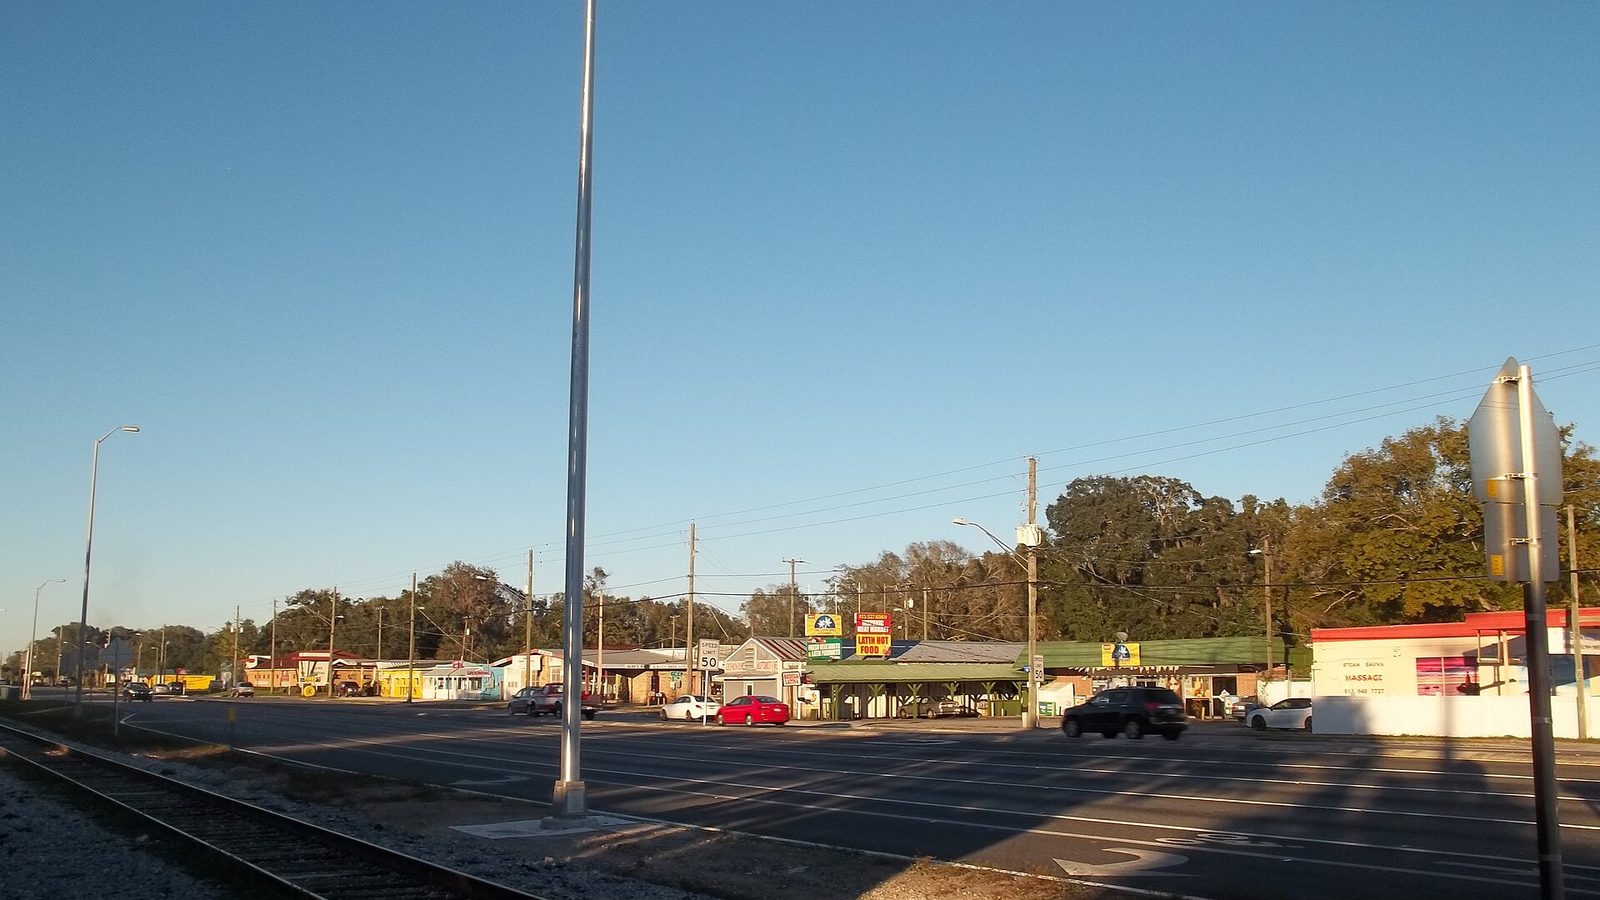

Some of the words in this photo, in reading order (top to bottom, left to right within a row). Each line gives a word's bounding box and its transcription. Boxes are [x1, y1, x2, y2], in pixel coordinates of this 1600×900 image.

[858, 636, 875, 645] LATIN
[876, 636, 889, 645] HOT
[860, 645, 879, 654] FOOD
[701, 657, 717, 667] 50
